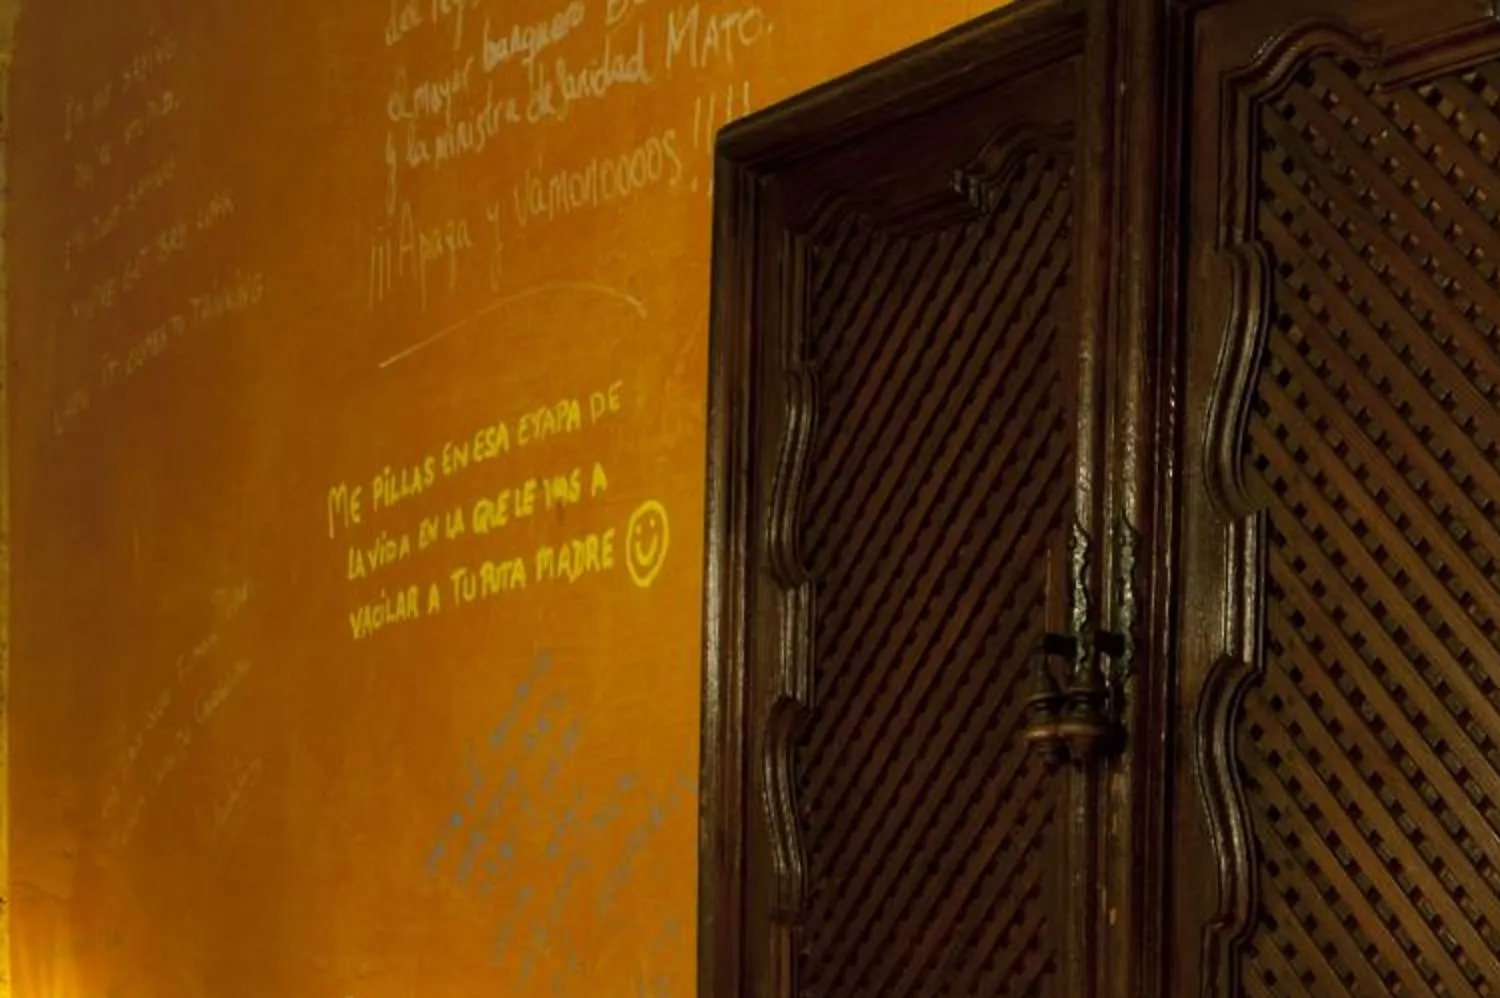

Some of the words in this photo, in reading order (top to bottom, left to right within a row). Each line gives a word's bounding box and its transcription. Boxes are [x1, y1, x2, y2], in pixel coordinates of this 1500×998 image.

[328, 480, 362, 540] ME
[442, 441, 469, 475] EN
[473, 421, 510, 462] ESA
[517, 398, 581, 446] ETAPA
[589, 379, 623, 424] DE
[347, 547, 366, 581] LA
[418, 516, 439, 550] EN
[446, 507, 466, 540] LA
[472, 488, 511, 534] QUE
[514, 478, 537, 518] LE
[591, 461, 608, 497] A
[427, 583, 441, 615] A
[450, 567, 477, 606] TU
[480, 557, 527, 600] PUTA
[535, 527, 616, 584] MADRE
